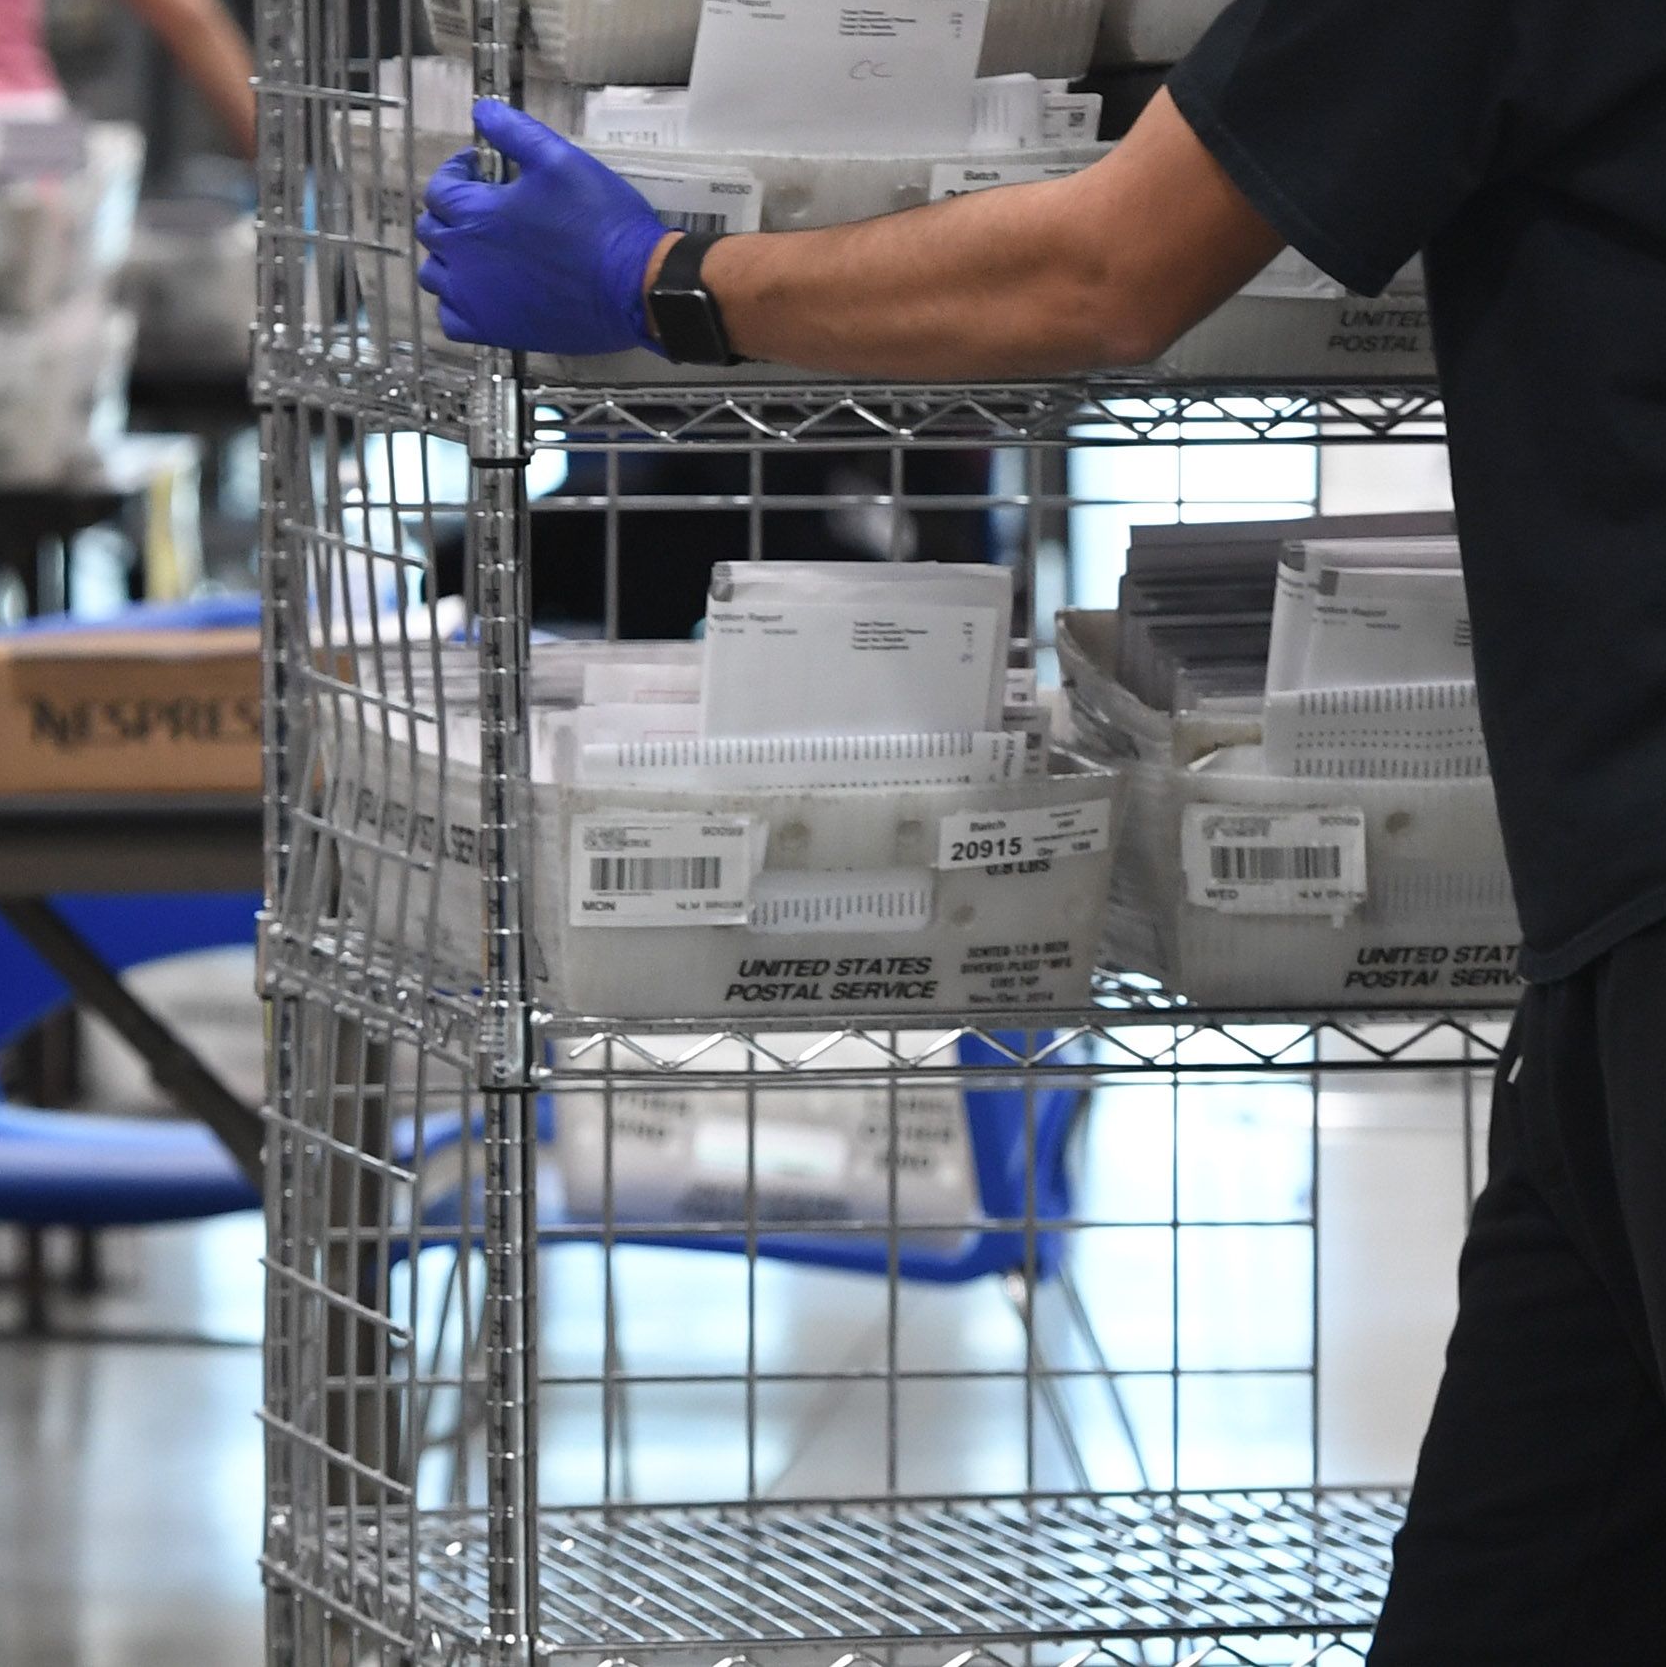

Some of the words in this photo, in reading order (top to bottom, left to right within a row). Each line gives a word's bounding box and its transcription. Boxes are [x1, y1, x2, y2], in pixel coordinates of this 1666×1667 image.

[963, 169, 1000, 182] Batch
[21, 690, 263, 754] NESPRES
[950, 836, 1022, 862] 20915
[581, 900, 617, 912] MON
[1356, 945, 1449, 966] UNITED
[1451, 943, 1523, 964] STAT
[738, 958, 831, 979] UNITED
[833, 956, 933, 976] STATES
[1450, 969, 1516, 988] SERV
[724, 982, 823, 1002] POSTAL
[829, 980, 938, 1001] SERVICE
